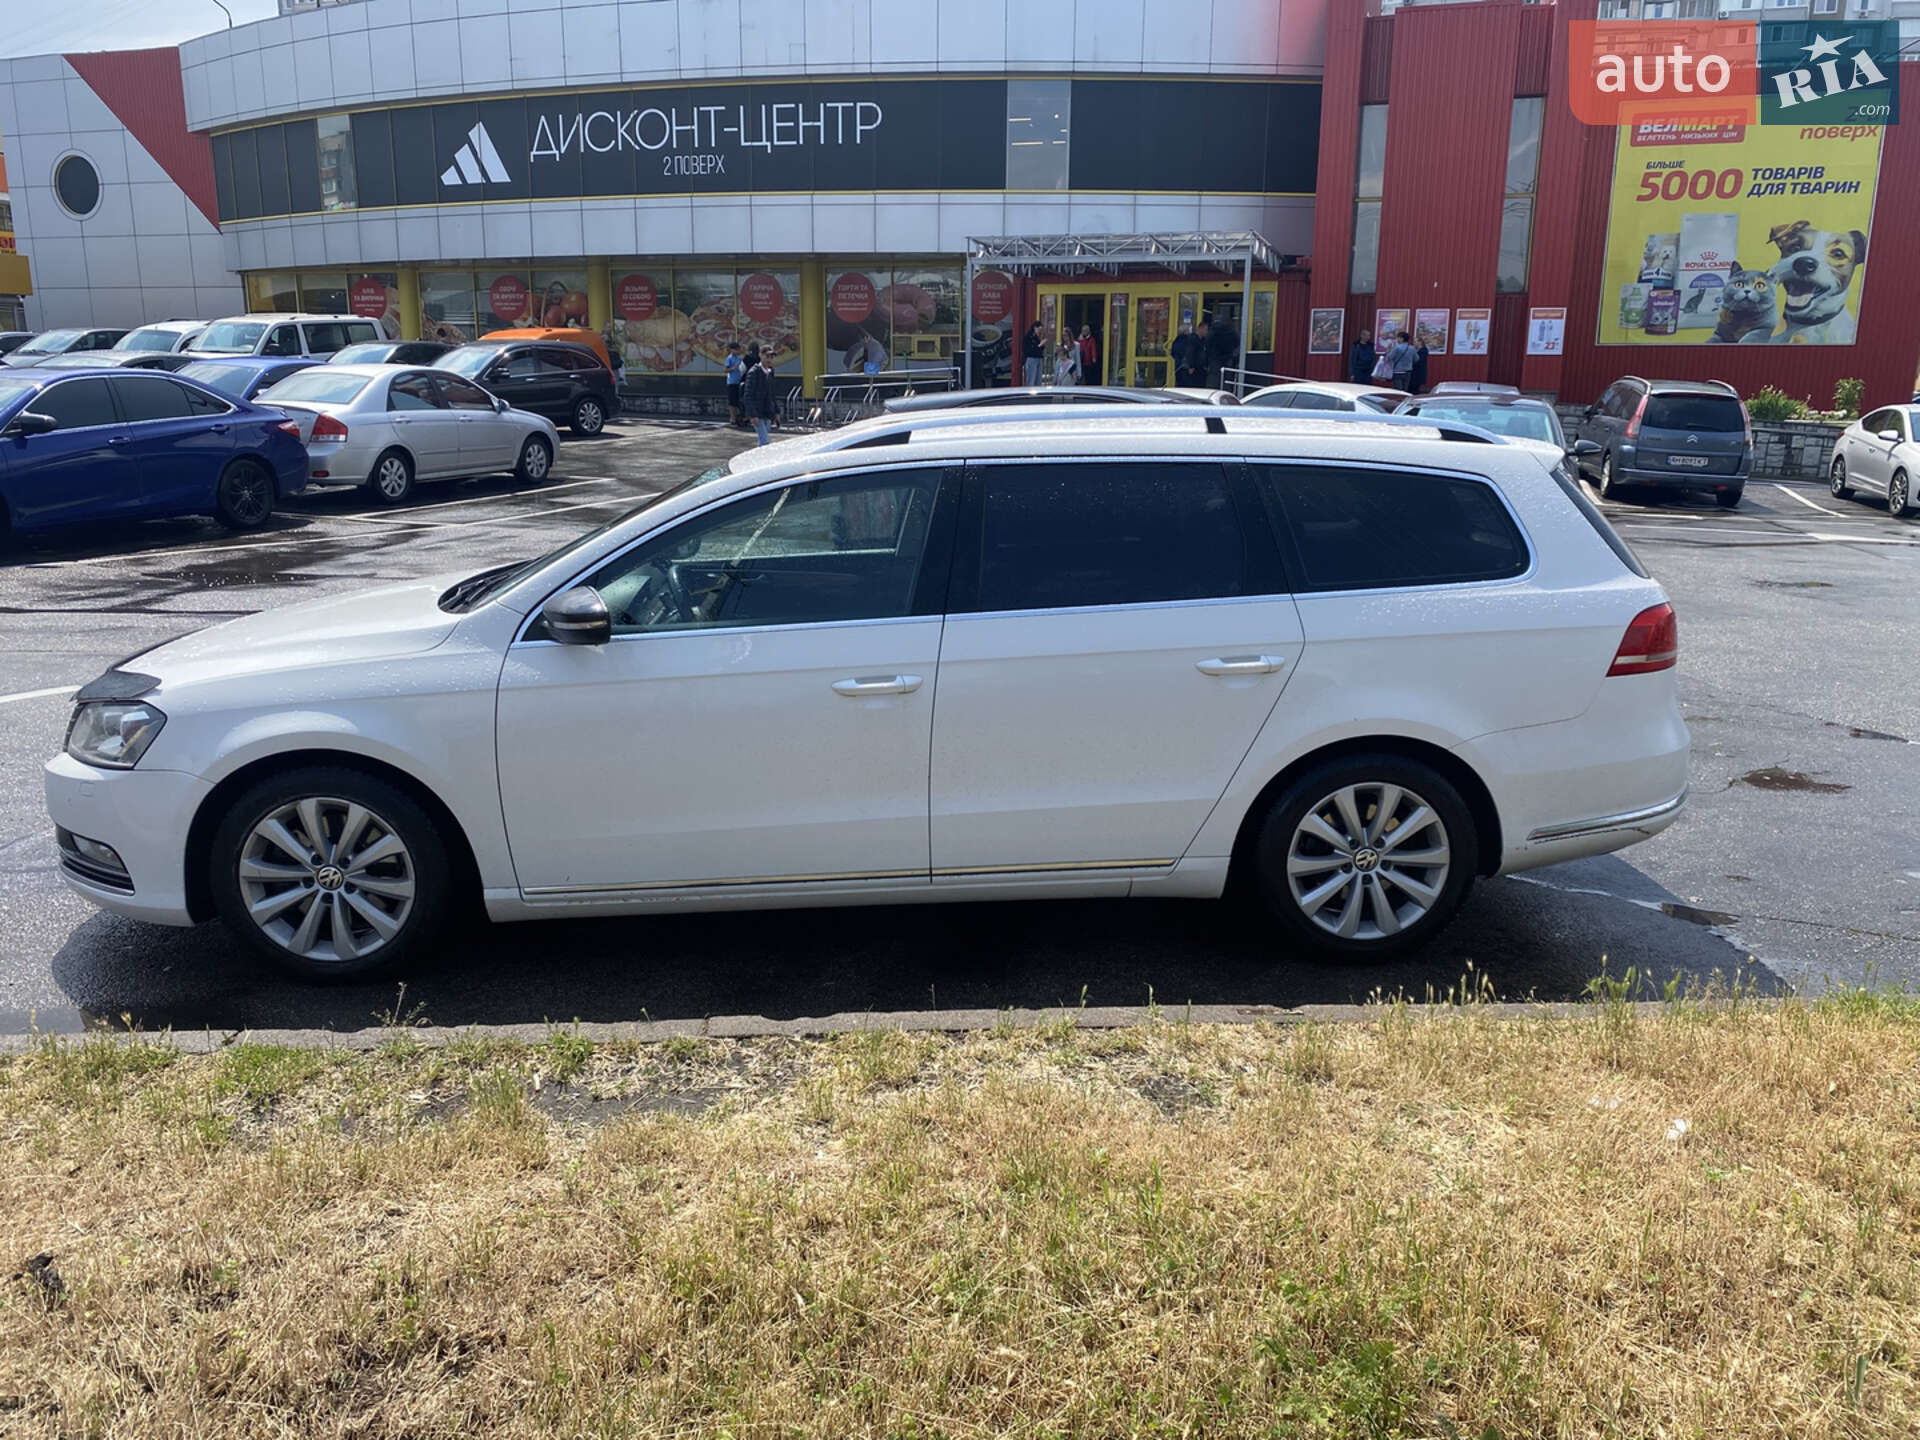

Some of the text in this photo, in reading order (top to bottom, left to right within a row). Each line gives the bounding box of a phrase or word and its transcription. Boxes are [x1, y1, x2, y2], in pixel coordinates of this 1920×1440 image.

[529, 101, 883, 163] ДИСКОНТ-ЦЕНТР
[1639, 115, 1740, 134] ВЕЛМАРТ
[1800, 125, 1879, 142] поверх
[663, 154, 725, 176] 2 ПОВЕРХ
[1646, 160, 1686, 170] БІЛЬШЕ
[1751, 166, 1825, 181] ТОВАРІВ
[1636, 168, 1744, 202] 5000
[1747, 180, 1861, 199] ДЛЯ ТВАРИН
